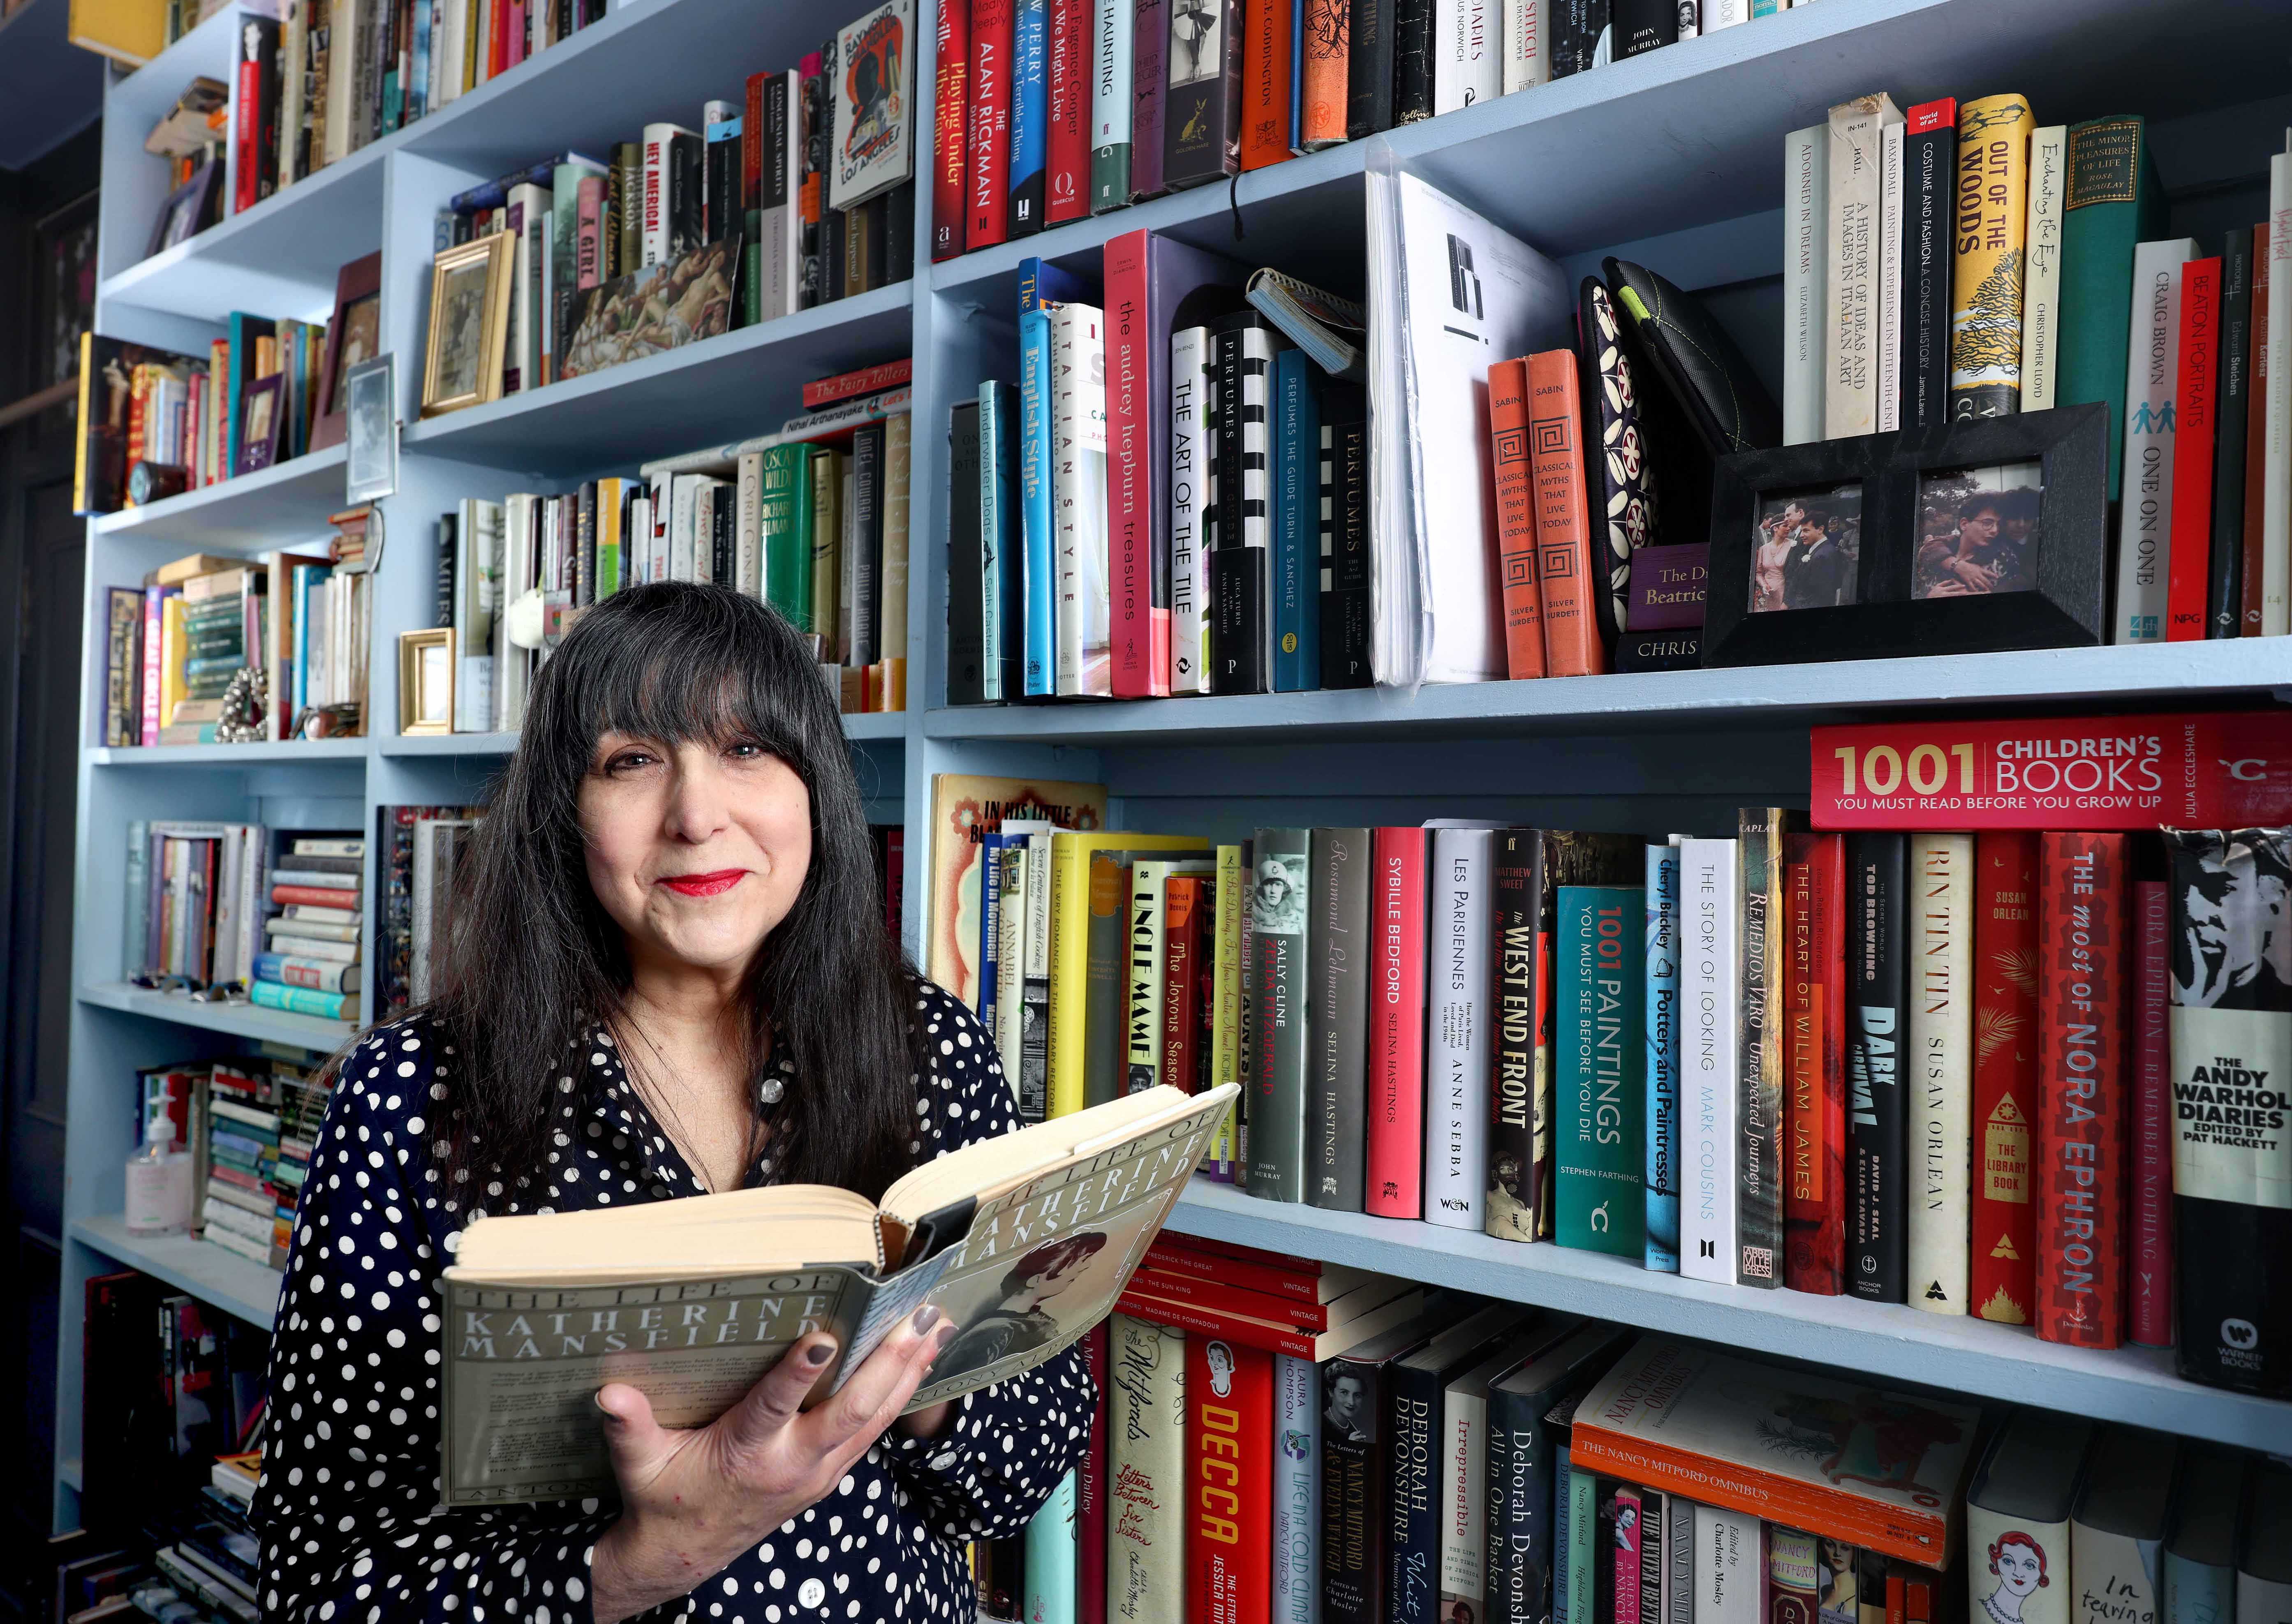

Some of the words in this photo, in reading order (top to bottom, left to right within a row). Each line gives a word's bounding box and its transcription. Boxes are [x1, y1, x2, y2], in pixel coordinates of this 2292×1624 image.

[846, 5, 893, 54] RAYMOND
[1102, 6, 1113, 96] HAUNTING
[1628, 39, 1661, 53] MURRAY
[1633, 28, 1654, 39] JOHN
[980, 43, 992, 100] ALAN
[1028, 23, 1040, 84] PERRY
[1262, 20, 1272, 106] CODDINGTON
[950, 62, 966, 129] Playing
[1919, 111, 1938, 120] world
[969, 105, 977, 150] DIARIES
[995, 109, 1005, 131] THE
[1848, 122, 1867, 132] IN-141
[2077, 139, 2095, 149] THE
[2098, 135, 2131, 144] MINOR
[947, 133, 964, 186] Under
[977, 106, 992, 207] RICKMAN
[1990, 141, 2008, 176] OUT
[2077, 147, 2129, 161] PLEASURES
[2083, 161, 2095, 171] OF
[2098, 159, 2121, 168] LIFE
[1052, 197, 1074, 206] QUERCUS
[1959, 146, 1983, 255] WOODS
[1987, 185, 2007, 206] OF
[1987, 215, 2006, 250] THE
[1119, 300, 1134, 335] the
[2154, 271, 2169, 322] CRAIG
[2151, 329, 2167, 385] BROWN
[816, 383, 835, 397] The
[839, 376, 868, 393] Fairy
[872, 367, 908, 385] Tellers
[1022, 346, 1039, 435] English
[1119, 344, 1136, 416] audrey
[1176, 379, 1191, 423] THE
[1536, 385, 1563, 396] SABIN
[1022, 439, 1039, 498] Style
[1119, 424, 1137, 513] hepburn
[1176, 433, 1191, 473] ART
[2142, 447, 2160, 493] ONE
[745, 474, 755, 520] CYRIL
[1175, 483, 1191, 513] OF
[1541, 476, 1568, 486] MYTHS
[1545, 491, 1566, 499] THAT
[1543, 518, 1571, 528] TODAY
[1547, 505, 1565, 513] LIVE
[2139, 500, 2158, 531] ON
[1175, 522, 1191, 565] THE
[2137, 539, 2156, 585] ONE
[1124, 522, 1135, 620] treasures
[1175, 574, 1191, 614] TILE
[1547, 609, 1579, 619] BURDETT
[2174, 614, 2200, 624] NPG
[1834, 744, 1973, 796] 1001
[1996, 737, 2161, 759] CHILDREN'S
[1996, 758, 2162, 793] BOOKS
[1834, 799, 1869, 810] YOU
[1873, 798, 1918, 809] MUST
[1922, 797, 1960, 809] READ
[1966, 797, 2026, 809] BEFORE
[2032, 797, 2070, 809] YOU
[2077, 797, 2133, 808] GROW
[2139, 797, 2161, 808] UP
[1388, 857, 1402, 920] SYBILLE
[1660, 858, 1672, 899] Cheryl
[1701, 864, 1714, 893] THE
[1797, 864, 1809, 901] THE
[1927, 849, 1950, 897] RIN
[2074, 852, 2093, 895] THE
[1133, 893, 1153, 974] UNCLE
[1598, 906, 1621, 970] 1001
[1659, 902, 1671, 949] Buckley
[1701, 902, 1714, 954] STORY
[1798, 910, 1809, 972] HEART
[1927, 908, 1949, 958] TIN
[2073, 905, 2091, 972] most
[1265, 939, 1277, 992] ZELDA
[1278, 940, 1287, 981] SALLY
[1387, 924, 1400, 1004] BEDFORD
[1504, 926, 1530, 989] WEST
[1702, 962, 1714, 984] OF
[1277, 986, 1285, 1027] CLINE
[1797, 982, 1809, 1007] OF
[1925, 966, 1949, 1017] TIN
[2072, 982, 2091, 1012] OF
[1131, 979, 1152, 1058] MAME
[1503, 996, 1529, 1043] END
[1657, 989, 1672, 1055] Potters
[1701, 991, 1714, 1072] LOOKING
[1263, 996, 1275, 1095] FITZGERALD
[1327, 1033, 1336, 1082] SELINA
[1597, 981, 1621, 1145] PAINTINGS
[1797, 1015, 1809, 1109] WILLIAM
[1862, 1005, 1895, 1086] DARK
[2214, 1057, 2241, 1068] THE
[1452, 1060, 1462, 1111] ANNE
[1501, 1049, 1528, 1128] FRONT
[1656, 1059, 1672, 1093] and
[1928, 1037, 1944, 1111] SUSAN
[2065, 1023, 2097, 1125] NORA
[2191, 1066, 2268, 1089] ANDY
[2174, 1084, 2291, 1111] WARHOL
[2177, 1102, 2283, 1130] DIARIES
[1325, 1092, 1335, 1165] HASTINGS
[1451, 1121, 1461, 1178] SEBBA
[1656, 1098, 1672, 1197] Paintresses
[1998, 1143, 2016, 1158] THE
[1255, 1171, 1281, 1180] MURRAY
[1561, 1166, 1596, 1177] STEPHEN
[1599, 1172, 1639, 1183] FARTHING
[1796, 1120, 1809, 1200] JAMES
[1927, 1122, 1943, 1212] ORLEAN
[1987, 1158, 2026, 1176] LIBRARY
[1994, 1175, 2019, 1190] BOOK
[2064, 1143, 2094, 1293] EPHRON
[1147, 1251, 1178, 1266] FREDERICK
[1193, 1262, 1213, 1272] GREAT
[464, 1287, 581, 1310] THE
[615, 1279, 733, 1305] LIFE
[768, 1275, 834, 1291] OF
[1283, 1282, 1310, 1294] VINTAGE
[465, 1295, 826, 1336] KATHERINE
[1290, 1310, 1318, 1321] VINTAGE
[460, 1319, 821, 1358] MANSFIELD
[1280, 1340, 1307, 1353] VINTAGE
[1297, 1368, 1306, 1407] LAURA
[1201, 1404, 1239, 1545] DECCA
[1394, 1396, 1409, 1543] DEVONSHIRE
[1412, 1400, 1427, 1512] DEBORAH
[1457, 1419, 1469, 1536] Irrepressible
[1513, 1430, 1531, 1523] Deborah
[1583, 1441, 1605, 1454] THE
[1607, 1448, 1649, 1467] NANCY
[1652, 1460, 1707, 1483] MITFORD
[1710, 1476, 1768, 1500] OMNIBUS
[1715, 1523, 1724, 1568] Charlotte
[1714, 1571, 1724, 1606] Mosley
[2106, 1575, 2139, 1598] In
